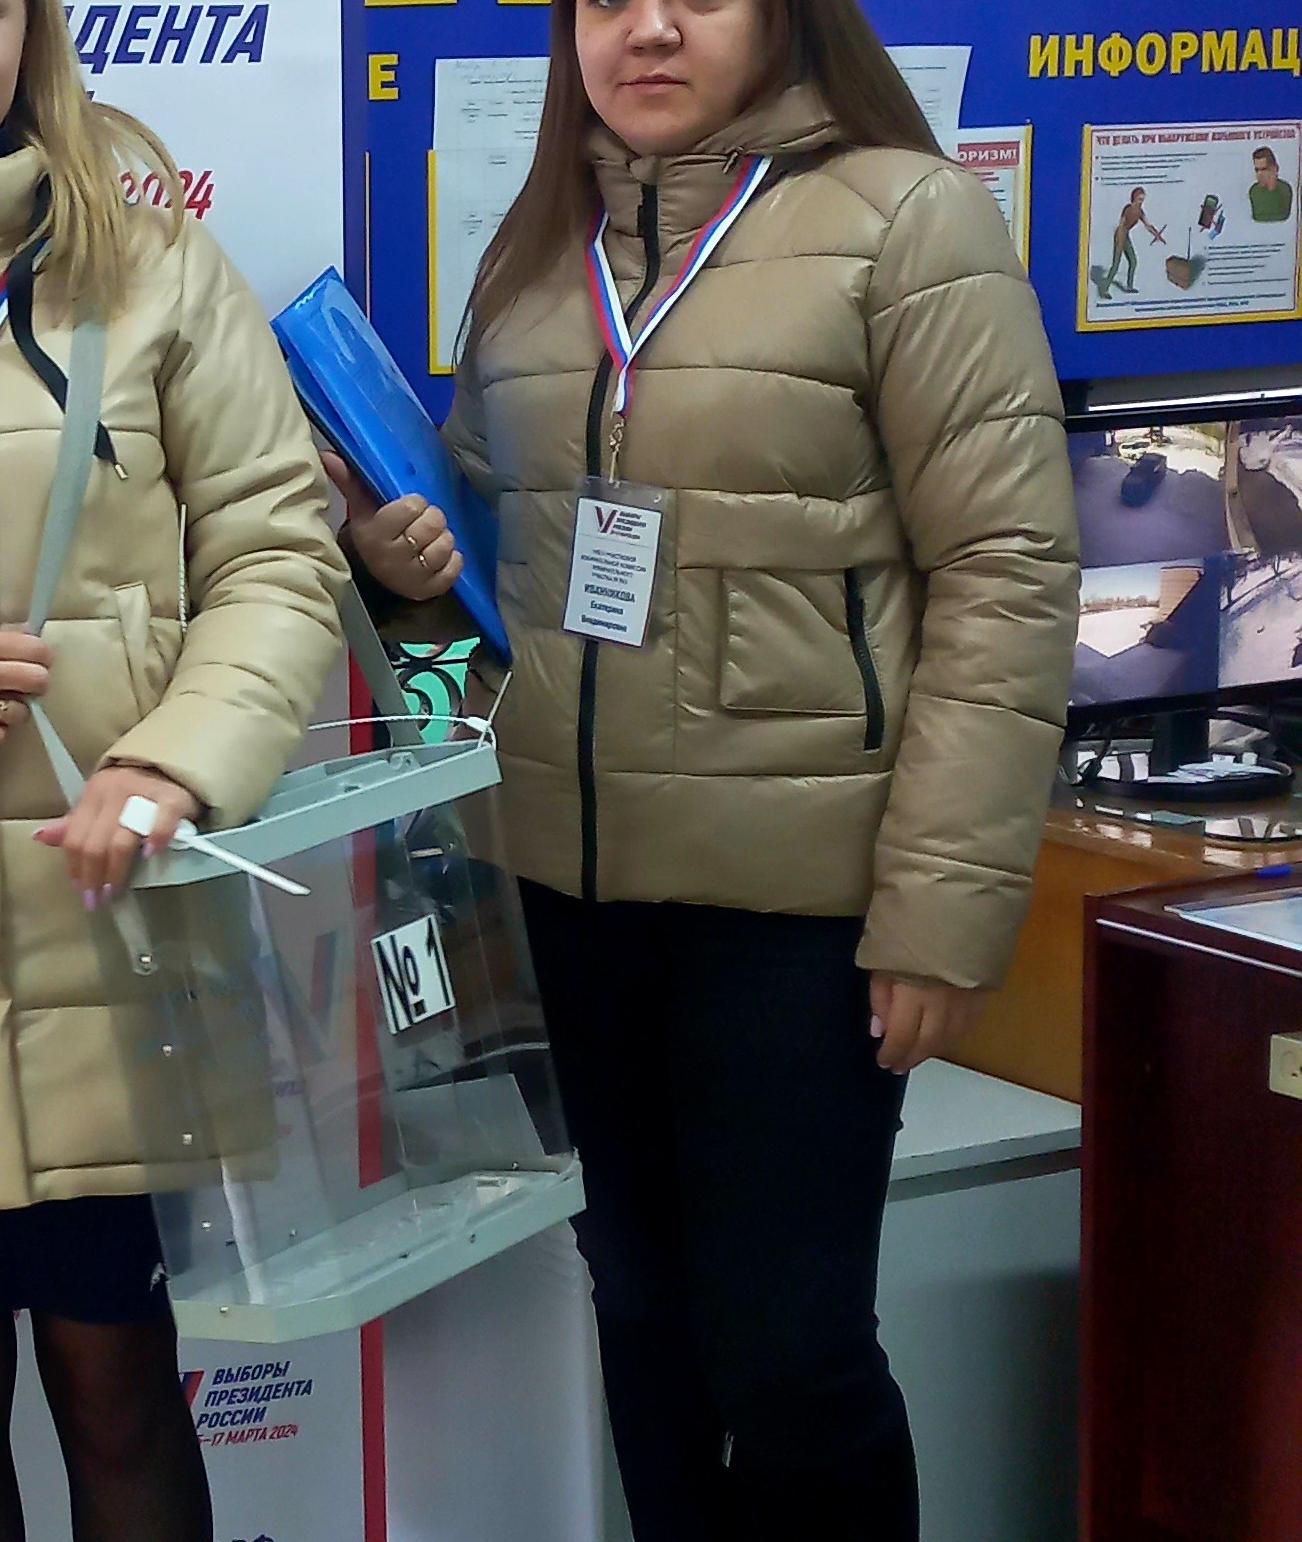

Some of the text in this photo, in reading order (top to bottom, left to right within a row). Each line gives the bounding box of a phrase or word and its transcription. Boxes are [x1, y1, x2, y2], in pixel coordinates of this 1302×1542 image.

[212, 1361, 291, 1385] ВЫБОРЫ
[204, 1379, 313, 1407] ПРЕЗИДЕНТА
[197, 1407, 267, 1429] РОССИИ
[225, 1427, 267, 1445] МАРТА
